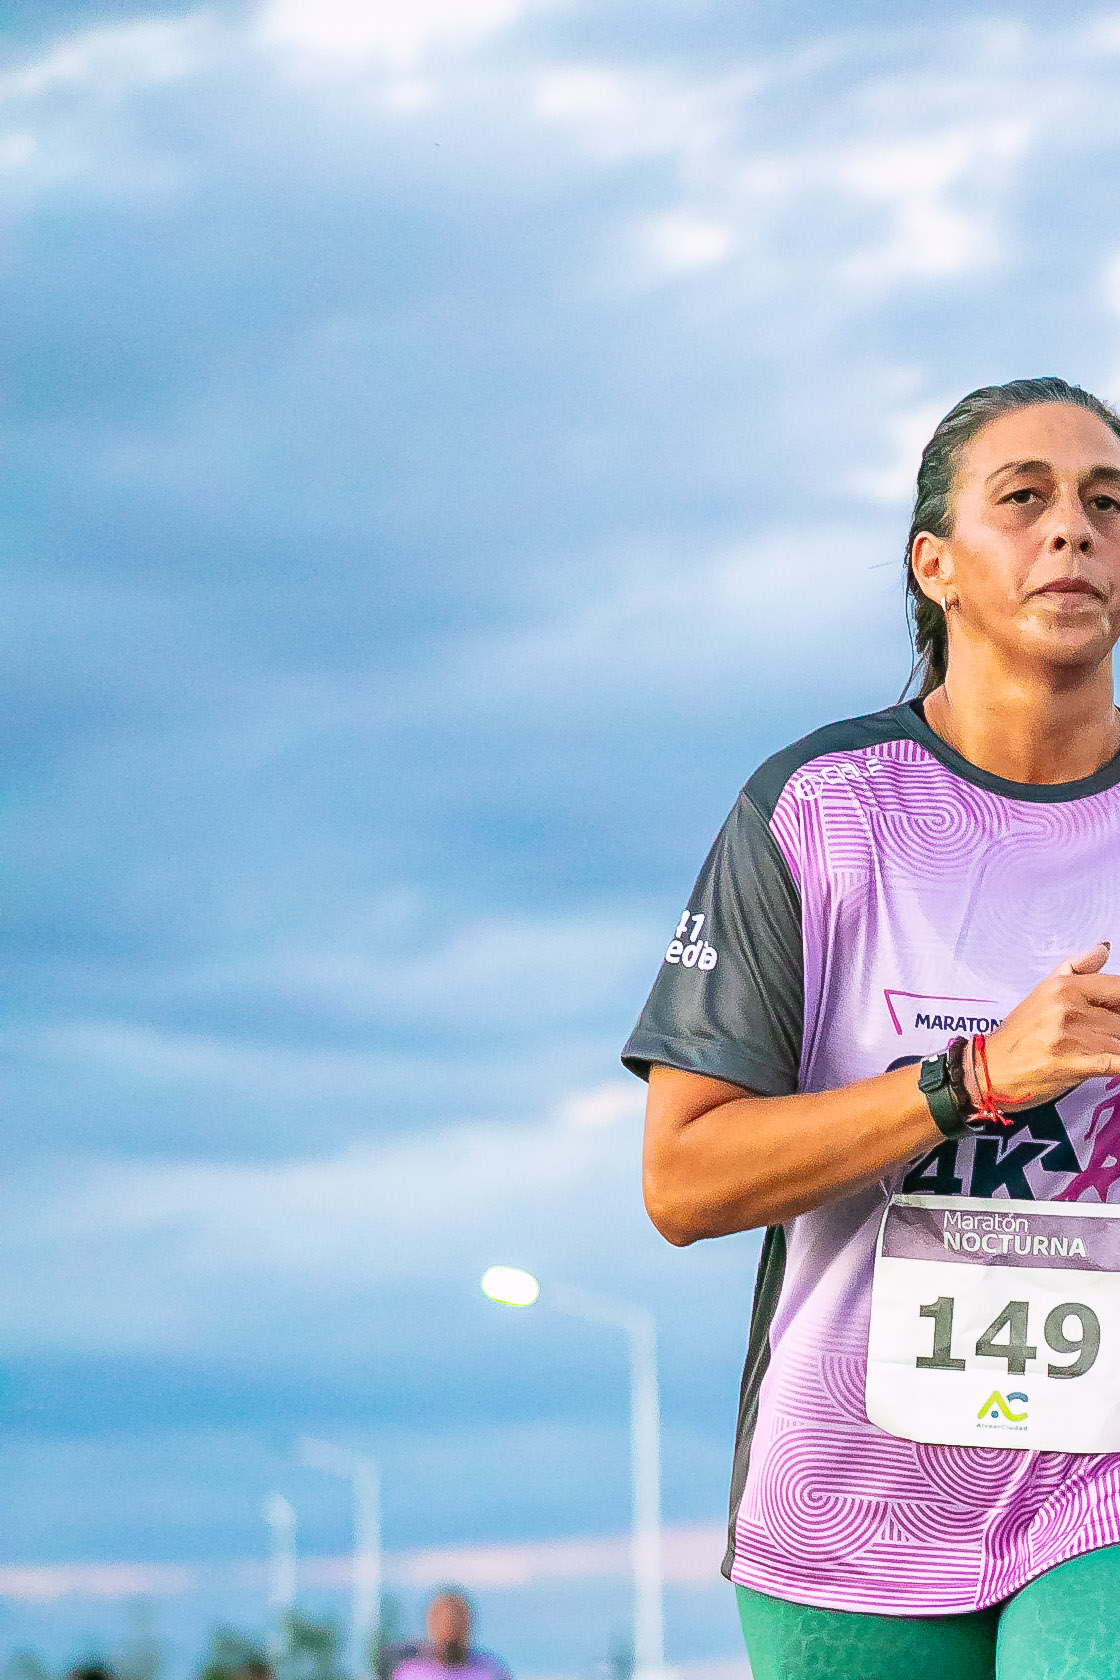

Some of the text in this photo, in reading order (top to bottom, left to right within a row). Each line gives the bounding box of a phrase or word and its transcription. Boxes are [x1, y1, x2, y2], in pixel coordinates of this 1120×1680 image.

[943, 1210, 1029, 1232] Maratón
[943, 1231, 1087, 1257] NOCTURNA
[916, 1296, 1101, 1379] 149
